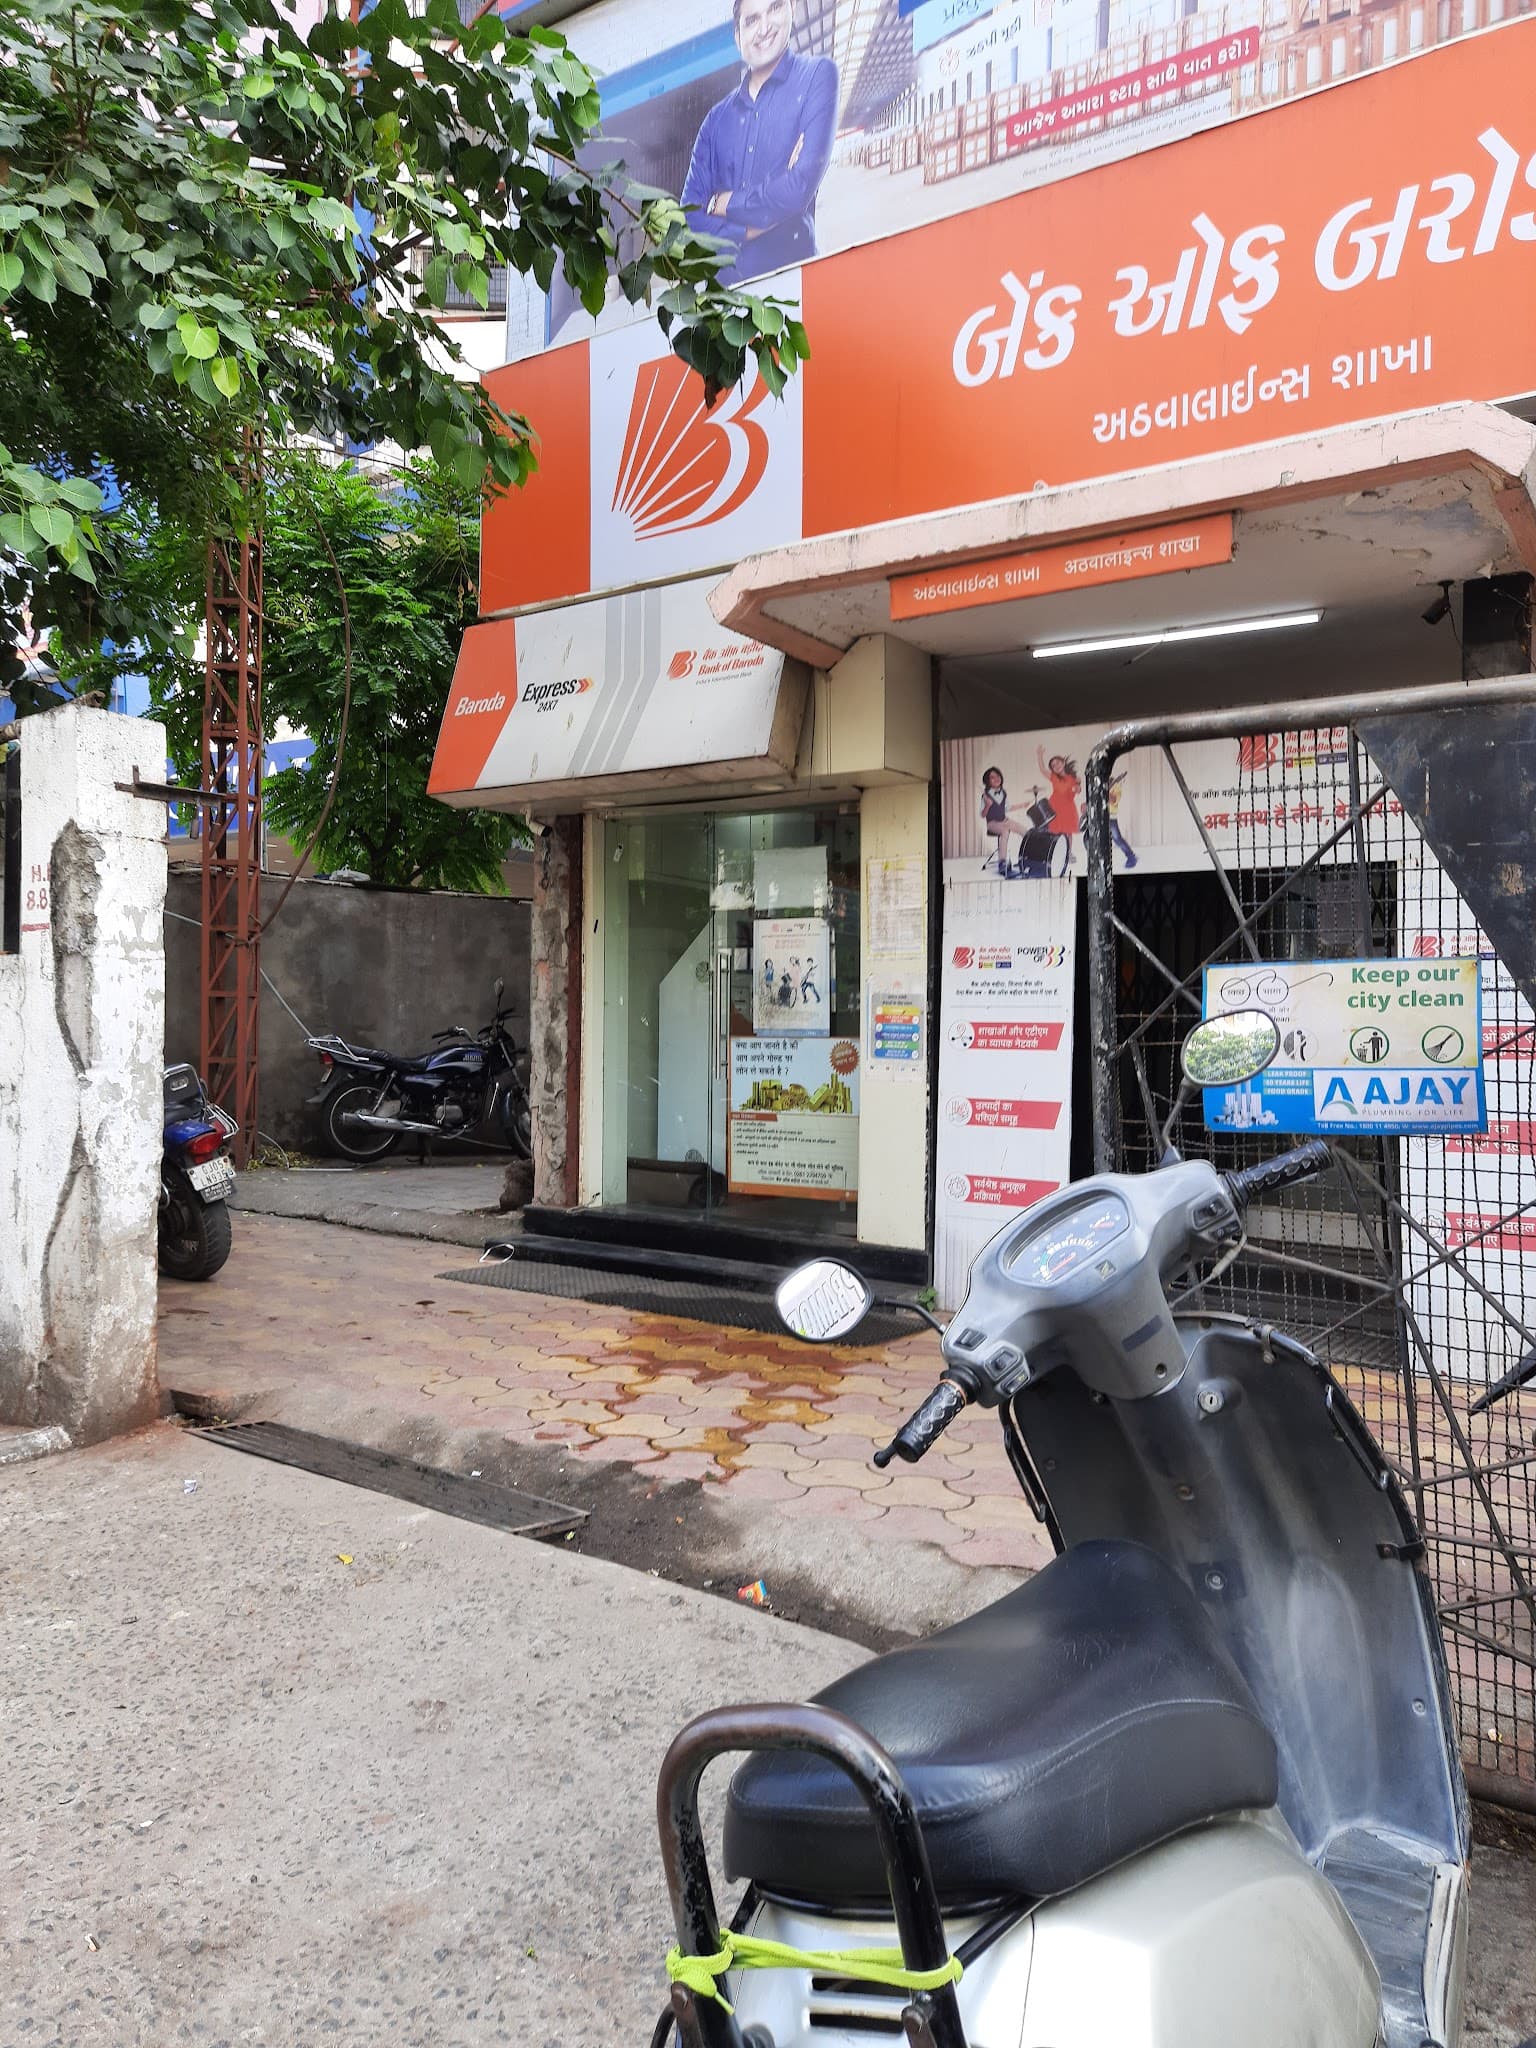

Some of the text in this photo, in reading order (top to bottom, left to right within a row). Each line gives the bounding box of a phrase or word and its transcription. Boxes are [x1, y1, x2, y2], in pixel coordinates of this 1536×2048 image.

[1061, 94, 1104, 120] અમારા
[1109, 79, 1142, 104] સ્ટાફ
[1146, 64, 1178, 90] સાથે
[1182, 54, 1213, 77] વાત
[1217, 38, 1251, 65] કરો!
[952, 269, 1082, 387] બેંક
[1107, 211, 1286, 335] ઓફ
[1331, 335, 1433, 390] શાખા
[1064, 535, 1201, 576] अठवालाइन्स शाखा
[1004, 565, 1041, 587] શાખા
[698, 655, 765, 676] Bank of Baroda
[521, 678, 578, 704] Express
[455, 691, 506, 717] Baroda
[537, 699, 559, 713] 24X7
[1204, 813, 1229, 830] अब
[1235, 810, 1268, 829] साथ
[1017, 946, 1049, 956] POWER
[1034, 955, 1045, 964] OF
[1351, 967, 1410, 988] Keep
[1417, 967, 1461, 983] our
[1347, 991, 1391, 1013] city
[1398, 990, 1464, 1008] clean
[978, 1024, 1049, 1038] शाखाओं और एटीएम
[977, 1038, 987, 1047] का
[989, 1038, 1012, 1048] व्यापक
[1002, 1103, 1012, 1111] का
[1361, 1109, 1464, 1117] PLUMBING FOR LIFE
[1330, 1122, 1344, 1130] Free
[201, 1160, 224, 1175] GJ05
